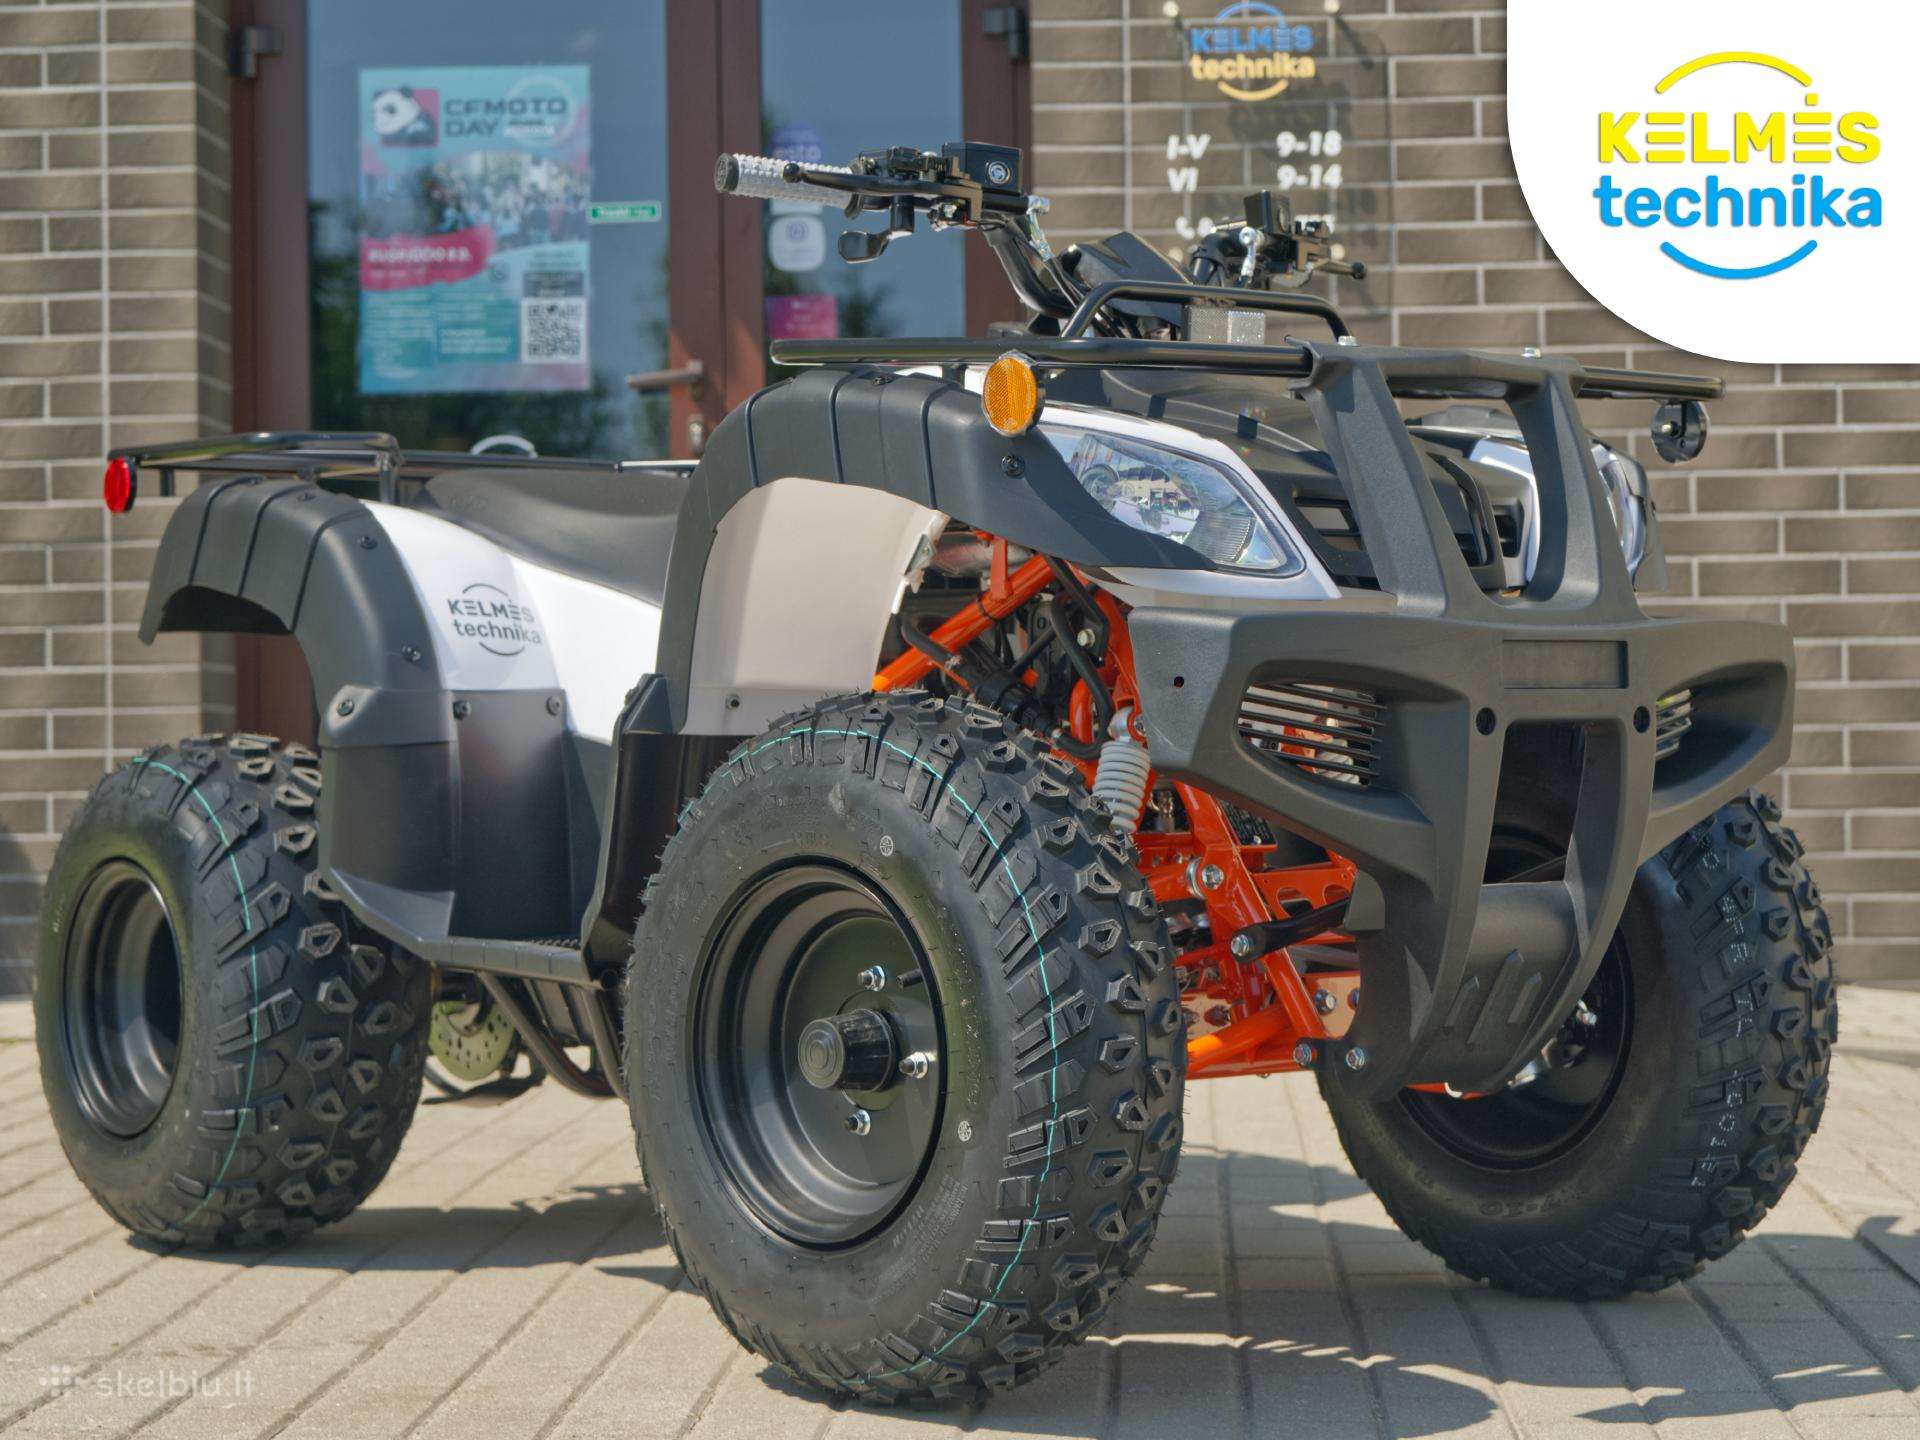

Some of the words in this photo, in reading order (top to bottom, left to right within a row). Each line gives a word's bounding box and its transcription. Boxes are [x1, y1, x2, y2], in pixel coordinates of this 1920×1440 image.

[1189, 52, 1316, 79] technika
[445, 98, 567, 115] CFMOTO
[445, 119, 498, 137] DAY
[1166, 133, 1212, 160] I-V
[1276, 130, 1342, 157] 9-18
[1166, 166, 1199, 193] VI
[1276, 163, 1343, 190] 9-14
[453, 619, 543, 645] technika
